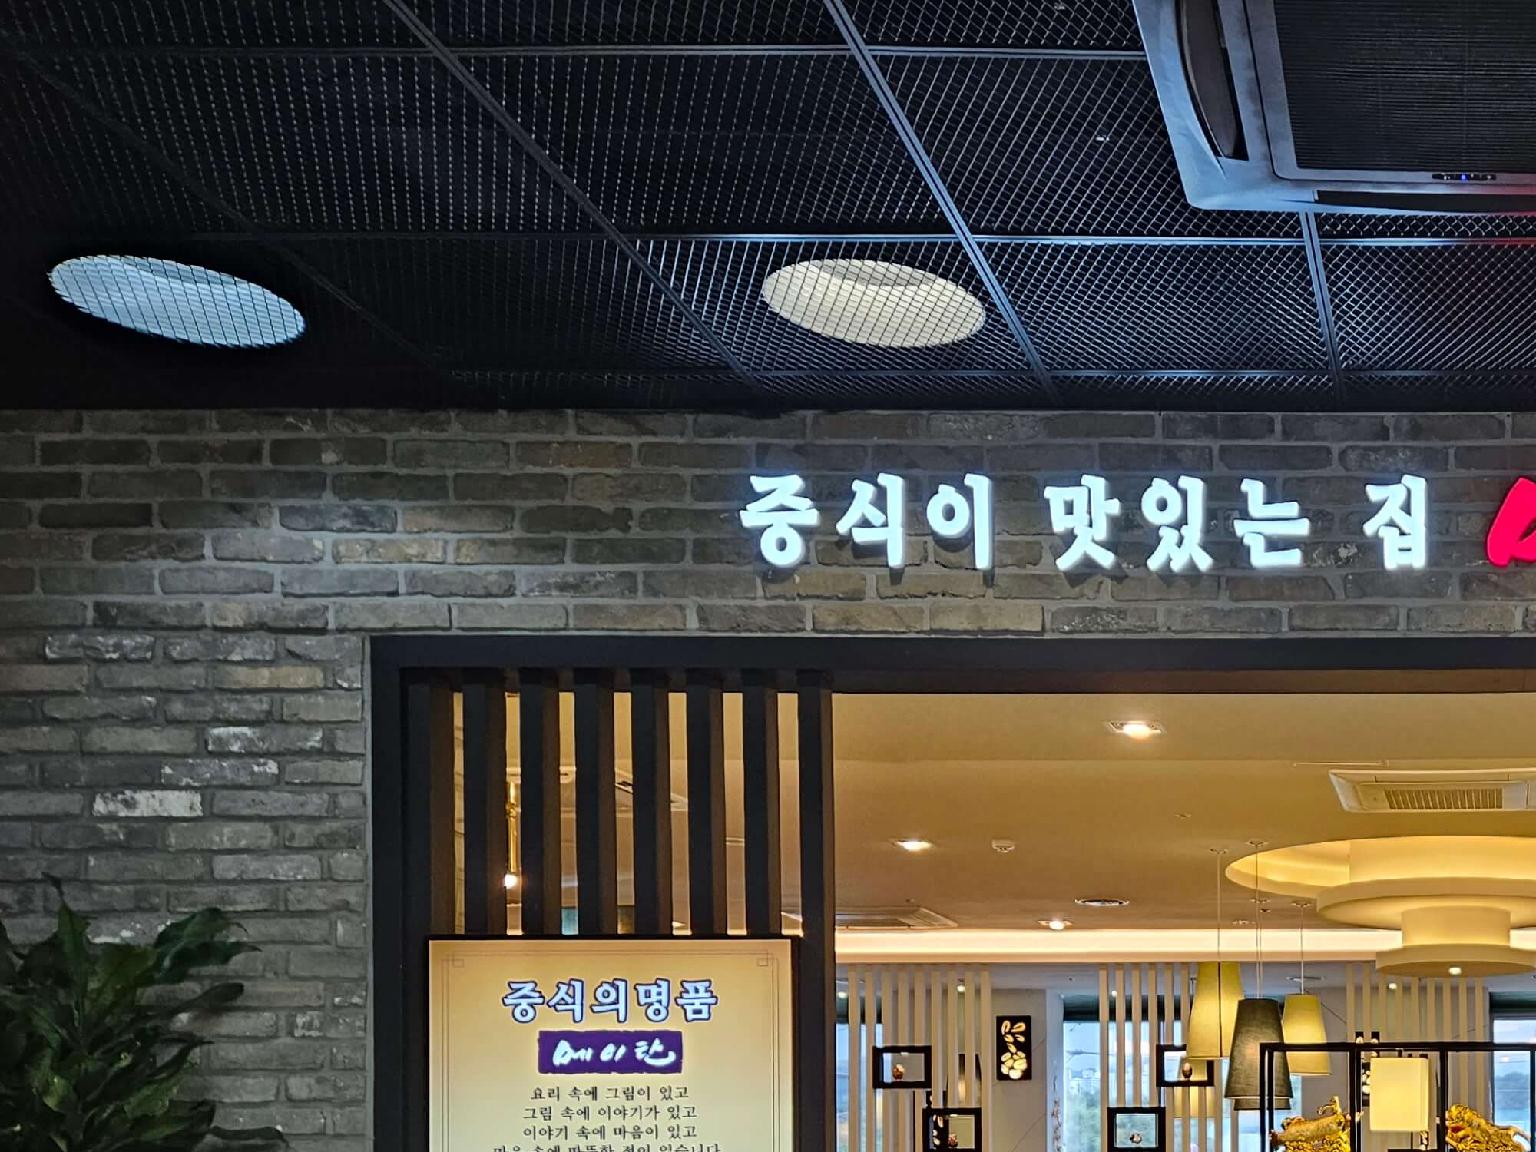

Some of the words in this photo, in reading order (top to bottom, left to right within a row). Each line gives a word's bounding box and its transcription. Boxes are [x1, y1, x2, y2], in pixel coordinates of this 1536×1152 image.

[739, 473, 993, 570] 중식이
[1045, 475, 1310, 573] 맛있는
[1362, 475, 1428, 570] 집
[530, 1087, 560, 1102] 요리
[568, 1087, 598, 1102] 속에
[605, 1087, 651, 1102] 그림이
[659, 1087, 689, 1102] 있고
[522, 1105, 552, 1121] 그림
[560, 1105, 590, 1121] 속에
[598, 1105, 660, 1121] 이야기가
[667, 1105, 697, 1121] 있고
[523, 1124, 568, 1140] 이야기
[576, 1124, 606, 1140] 속에
[613, 1124, 658, 1140] 마음이
[667, 1124, 697, 1140] 있고
